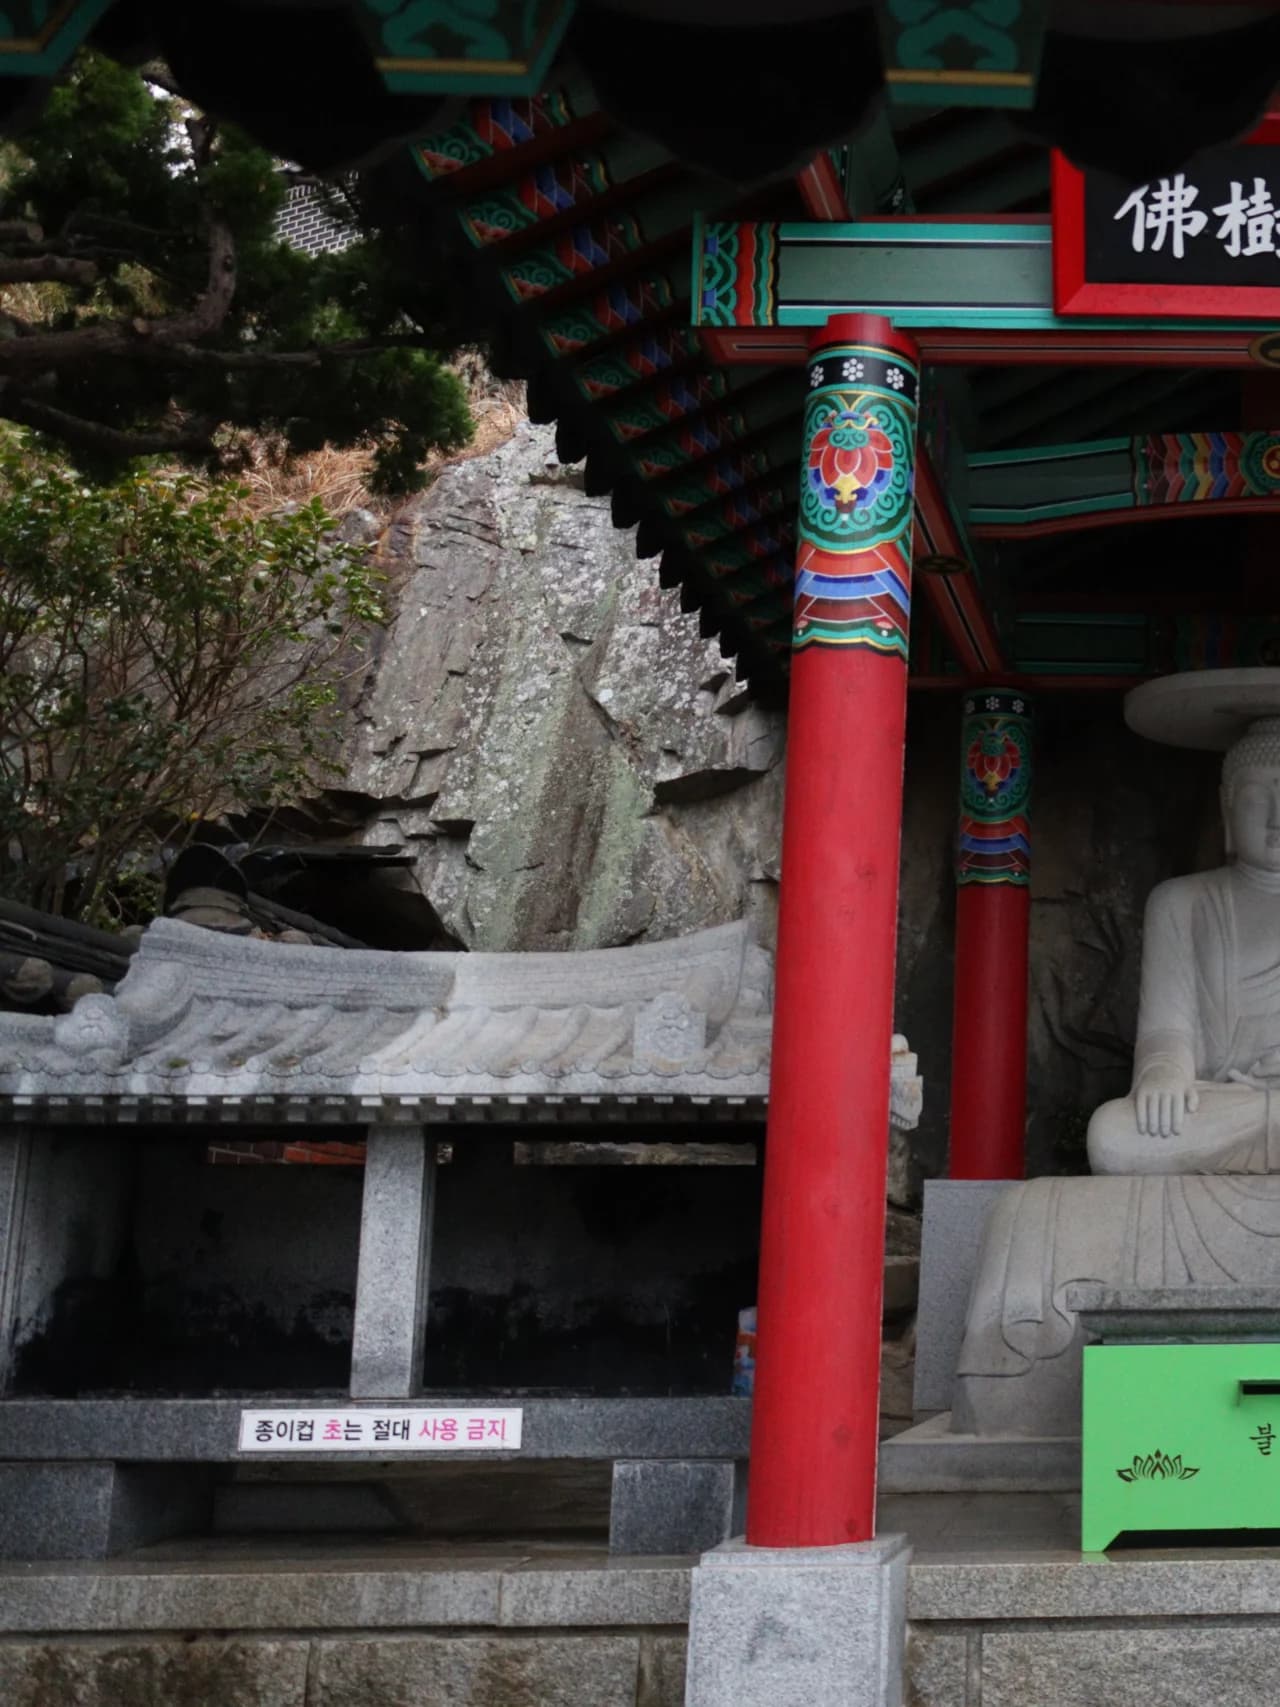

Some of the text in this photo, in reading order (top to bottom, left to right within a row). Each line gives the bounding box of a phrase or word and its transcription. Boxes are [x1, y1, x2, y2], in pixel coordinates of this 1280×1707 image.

[255, 1418, 506, 1442] 종이컵 초는 절대 사용 금지
